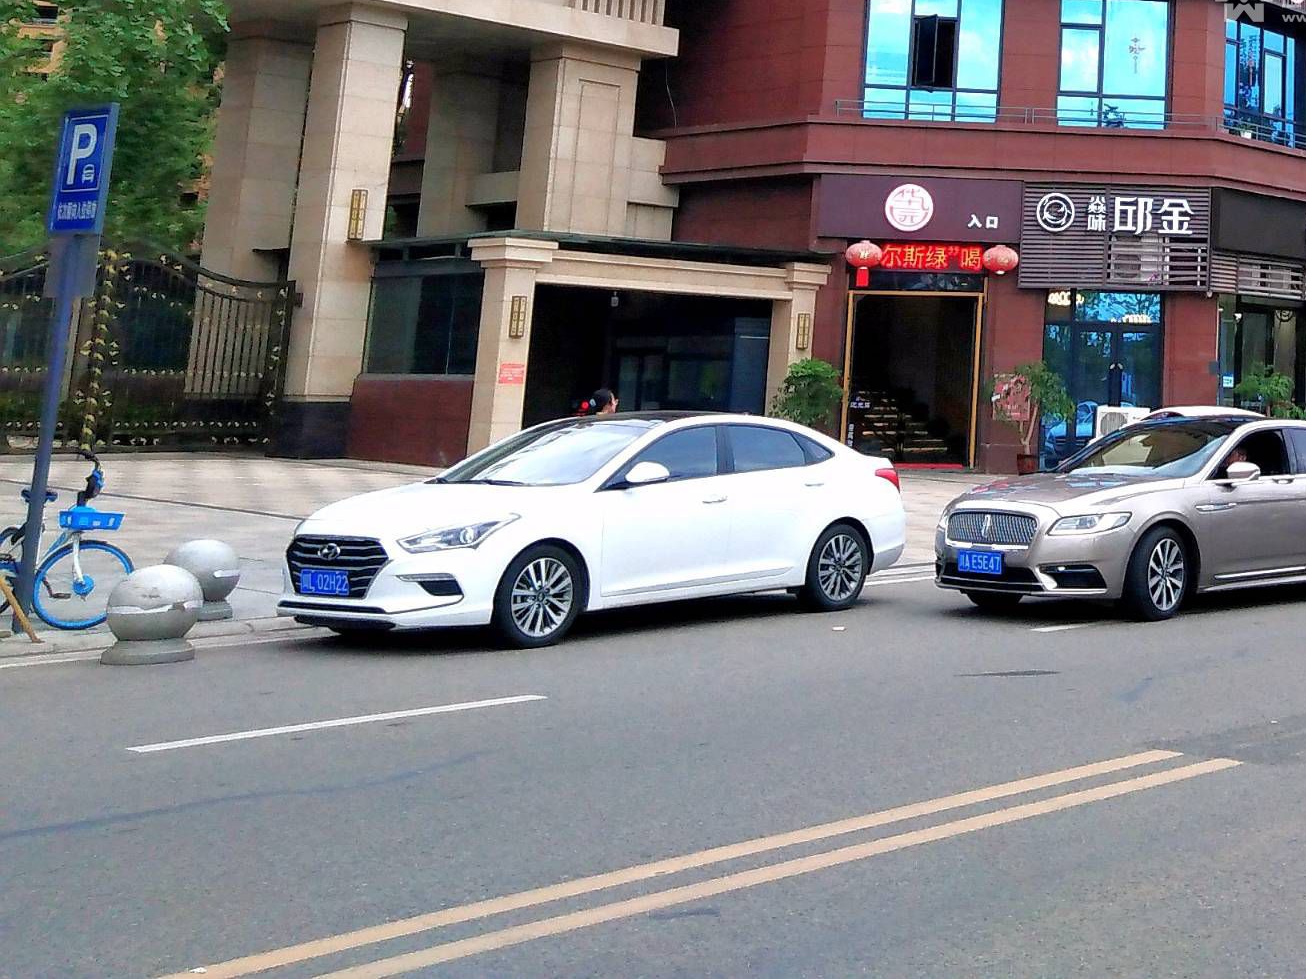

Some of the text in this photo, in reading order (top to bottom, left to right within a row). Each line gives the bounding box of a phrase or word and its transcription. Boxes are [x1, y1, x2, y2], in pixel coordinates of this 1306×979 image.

[66, 123, 98, 185] P
[968, 214, 998, 229] 入口
[1113, 197, 1194, 235] 邱金
